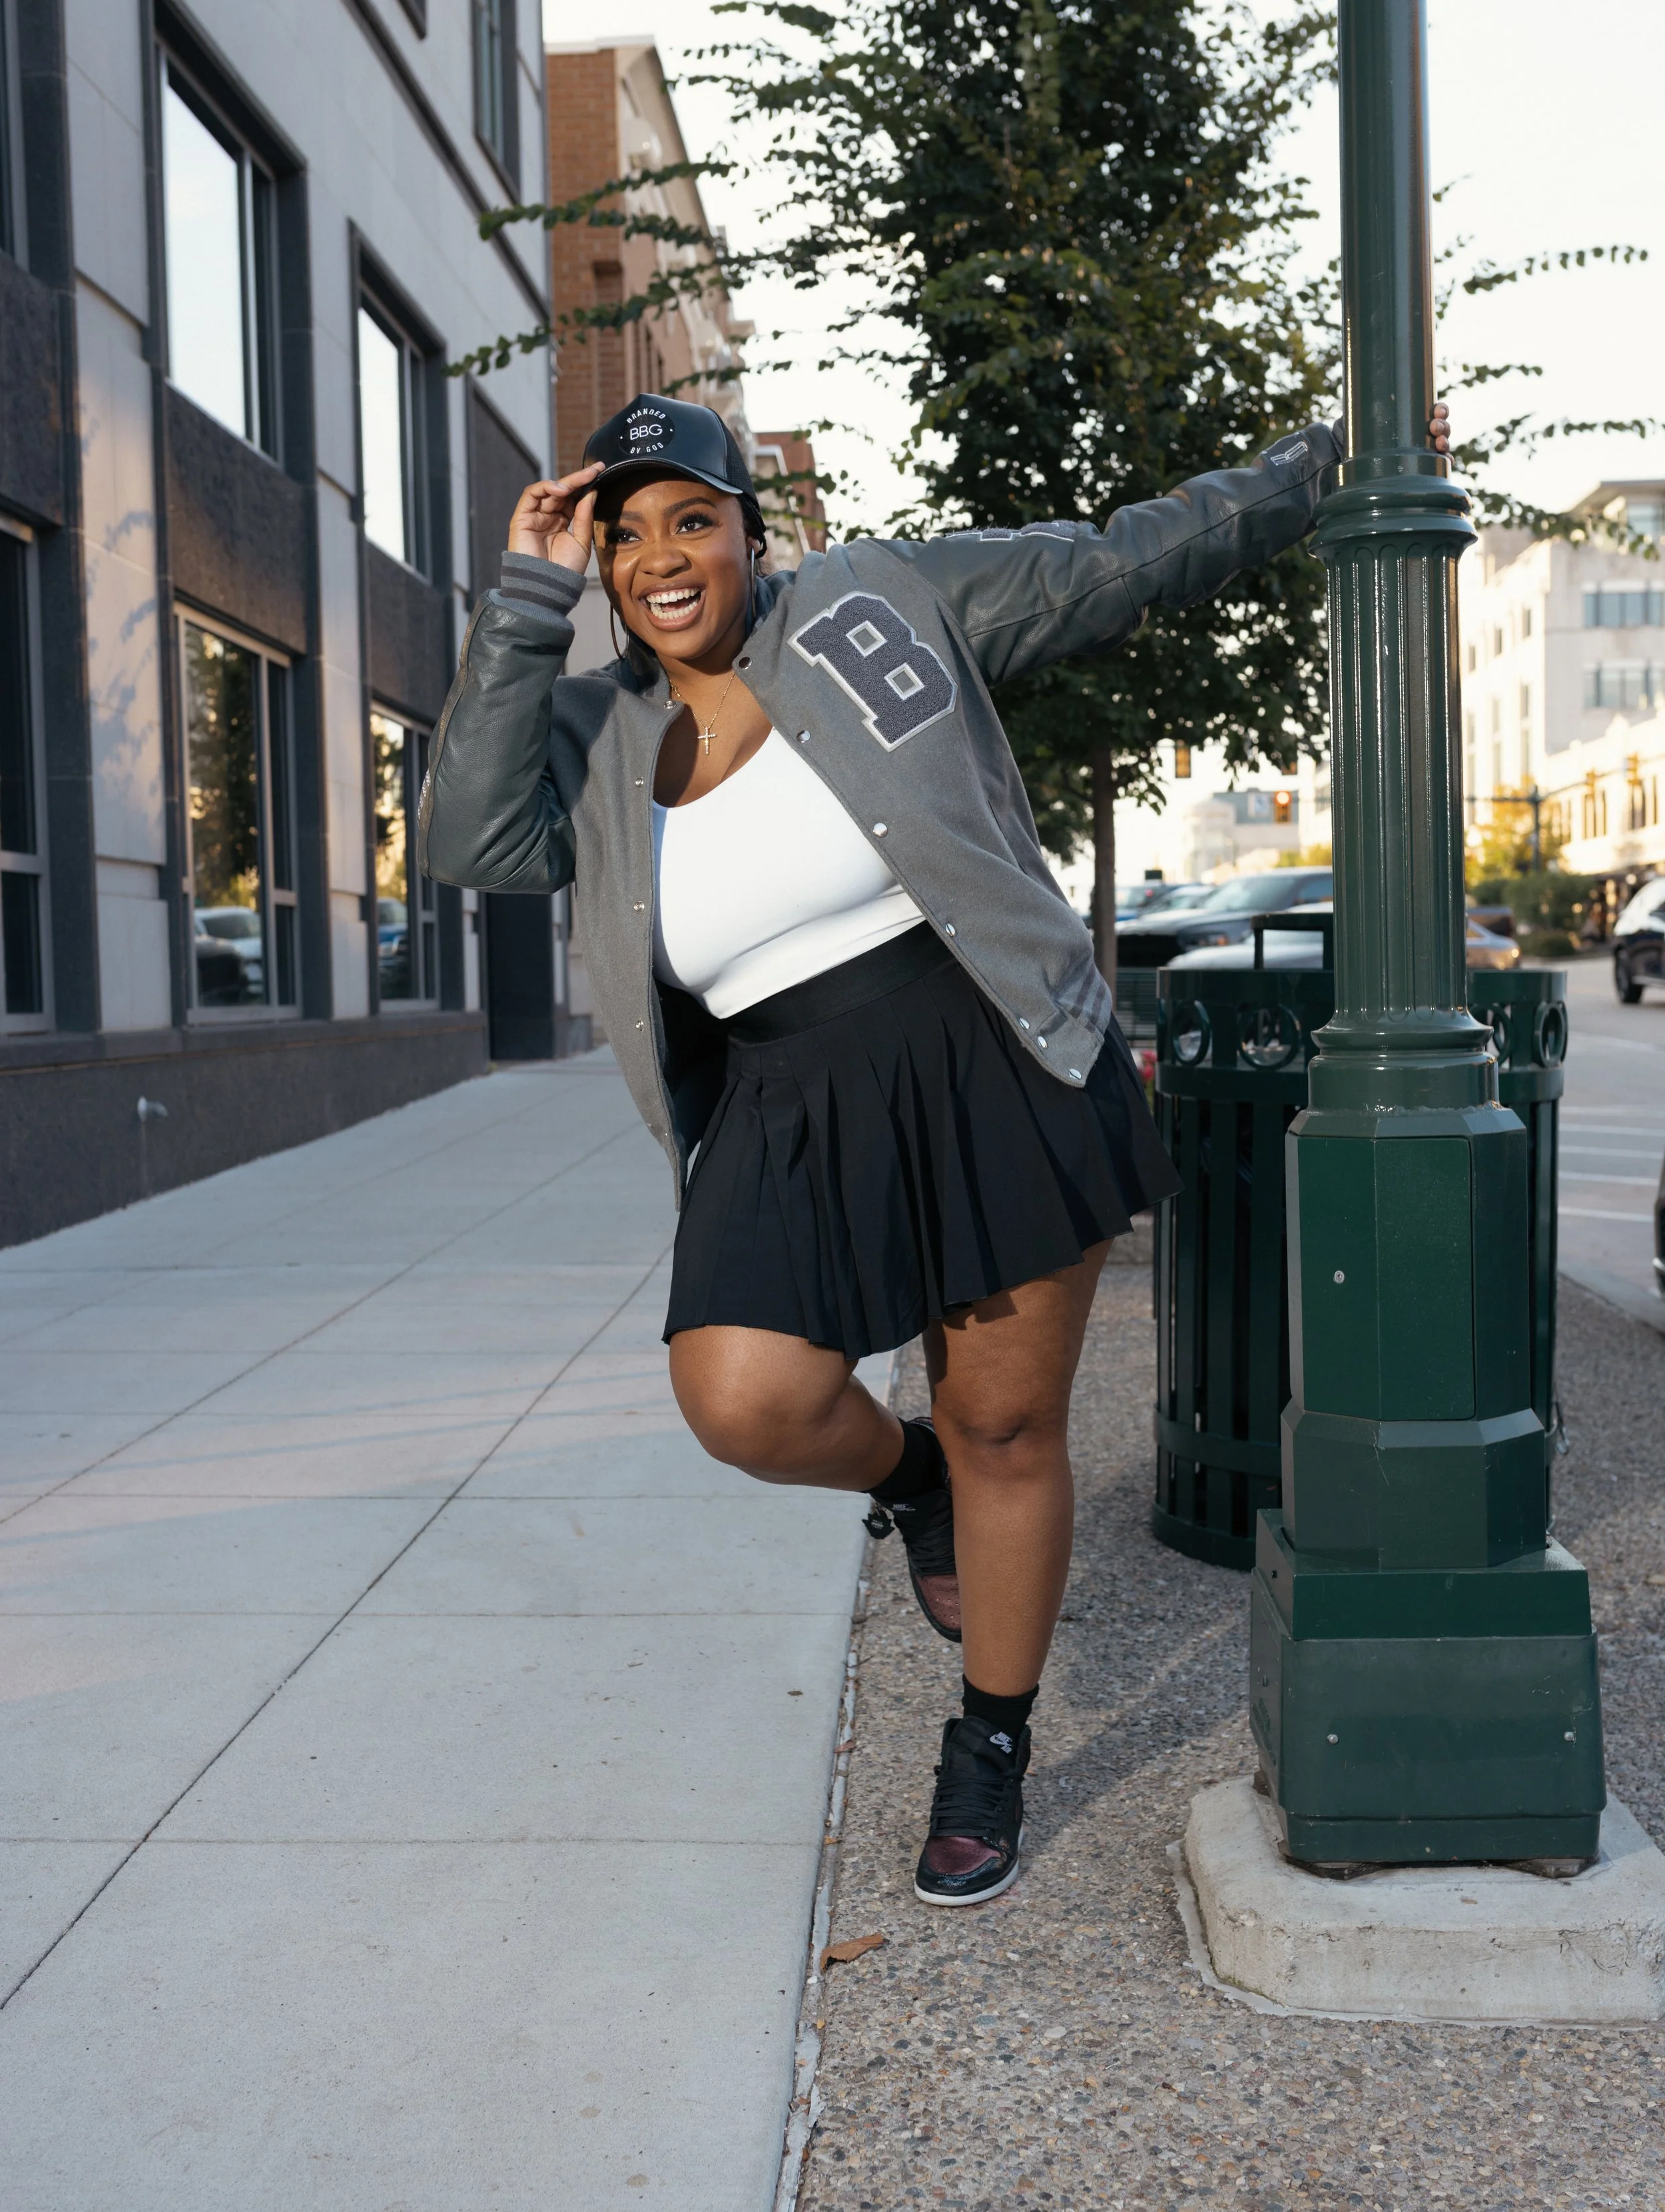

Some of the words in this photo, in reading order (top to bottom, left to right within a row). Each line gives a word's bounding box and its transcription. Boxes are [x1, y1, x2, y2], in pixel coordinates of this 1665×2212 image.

[627, 408, 666, 424] BRANDED
[630, 424, 663, 440] BBG
[646, 442, 664, 453] GOD
[787, 590, 958, 753] B
[996, 1732, 1011, 1743] NIKE
[1000, 1744, 1012, 1754] AIR
